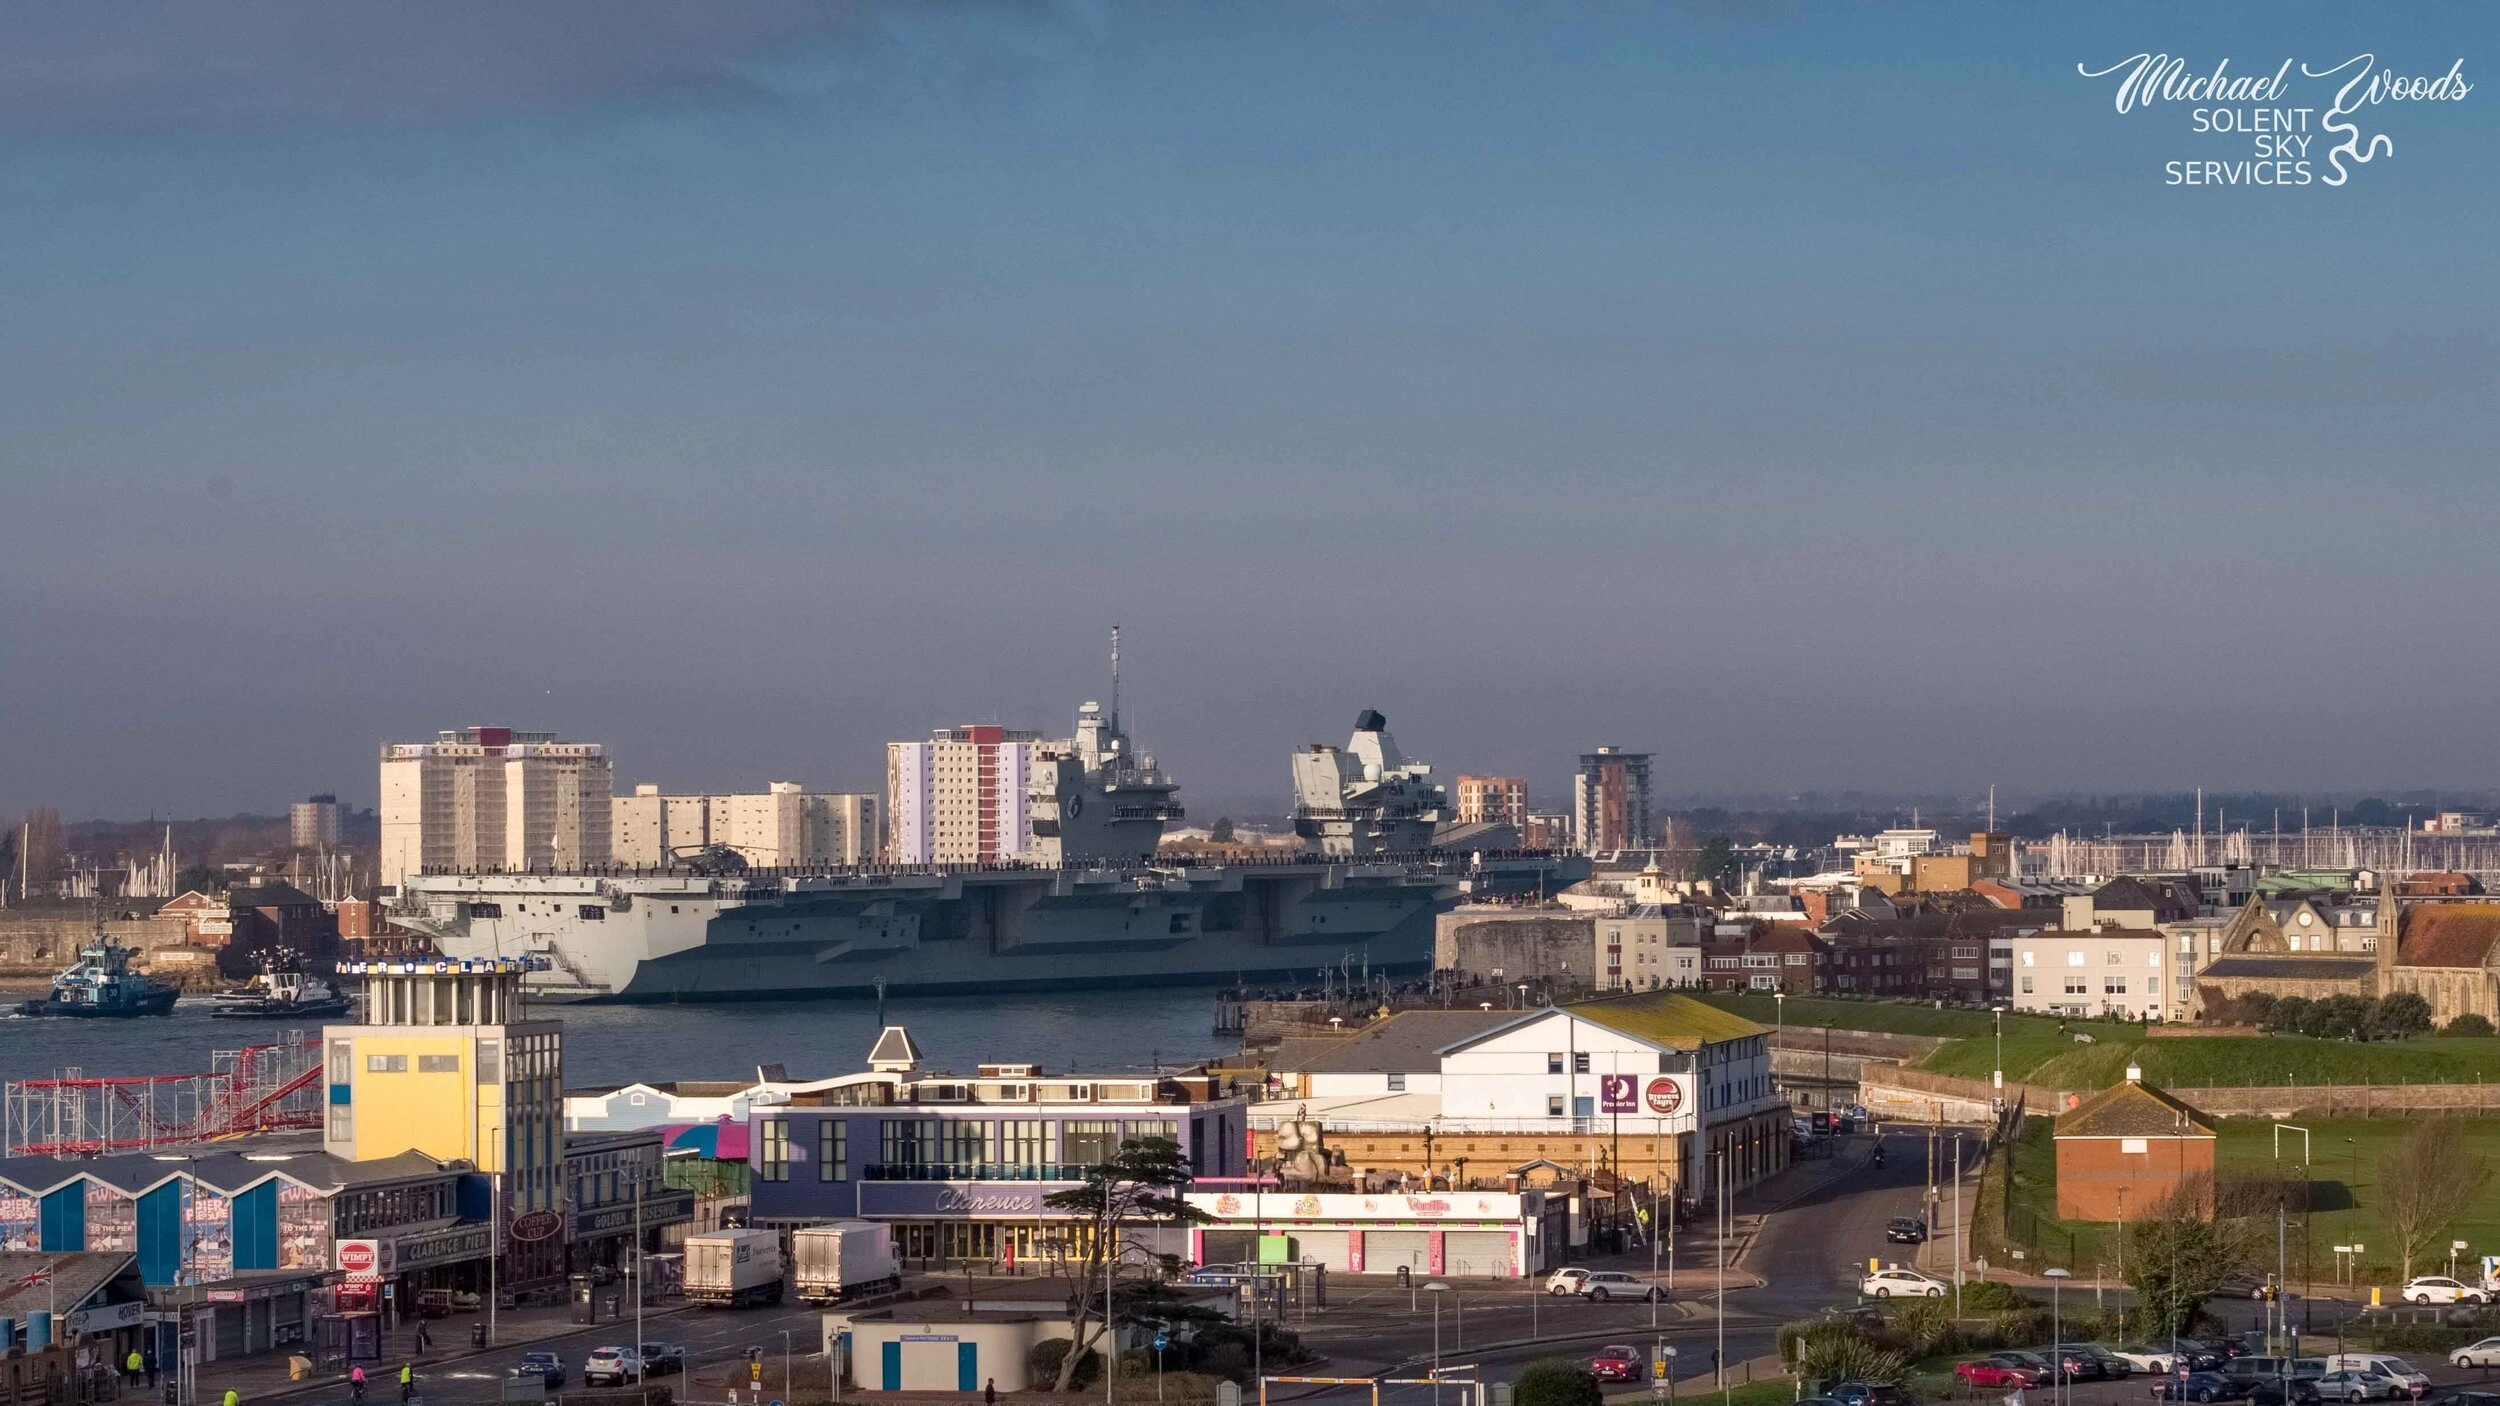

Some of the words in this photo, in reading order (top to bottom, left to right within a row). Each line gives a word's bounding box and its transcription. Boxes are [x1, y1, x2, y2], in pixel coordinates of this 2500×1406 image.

[1648, 1093, 1680, 1101] Brewers
[935, 1189, 1035, 1212] Clarence
[518, 1213, 553, 1229] COFFEE
[594, 1212, 627, 1229] GOLDEN
[309, 1224, 325, 1232] PIER
[527, 1226, 545, 1239] CUP
[410, 1238, 459, 1260] CLARENCE
[465, 1233, 487, 1250] PIER
[341, 1252, 374, 1262] WIMPY
